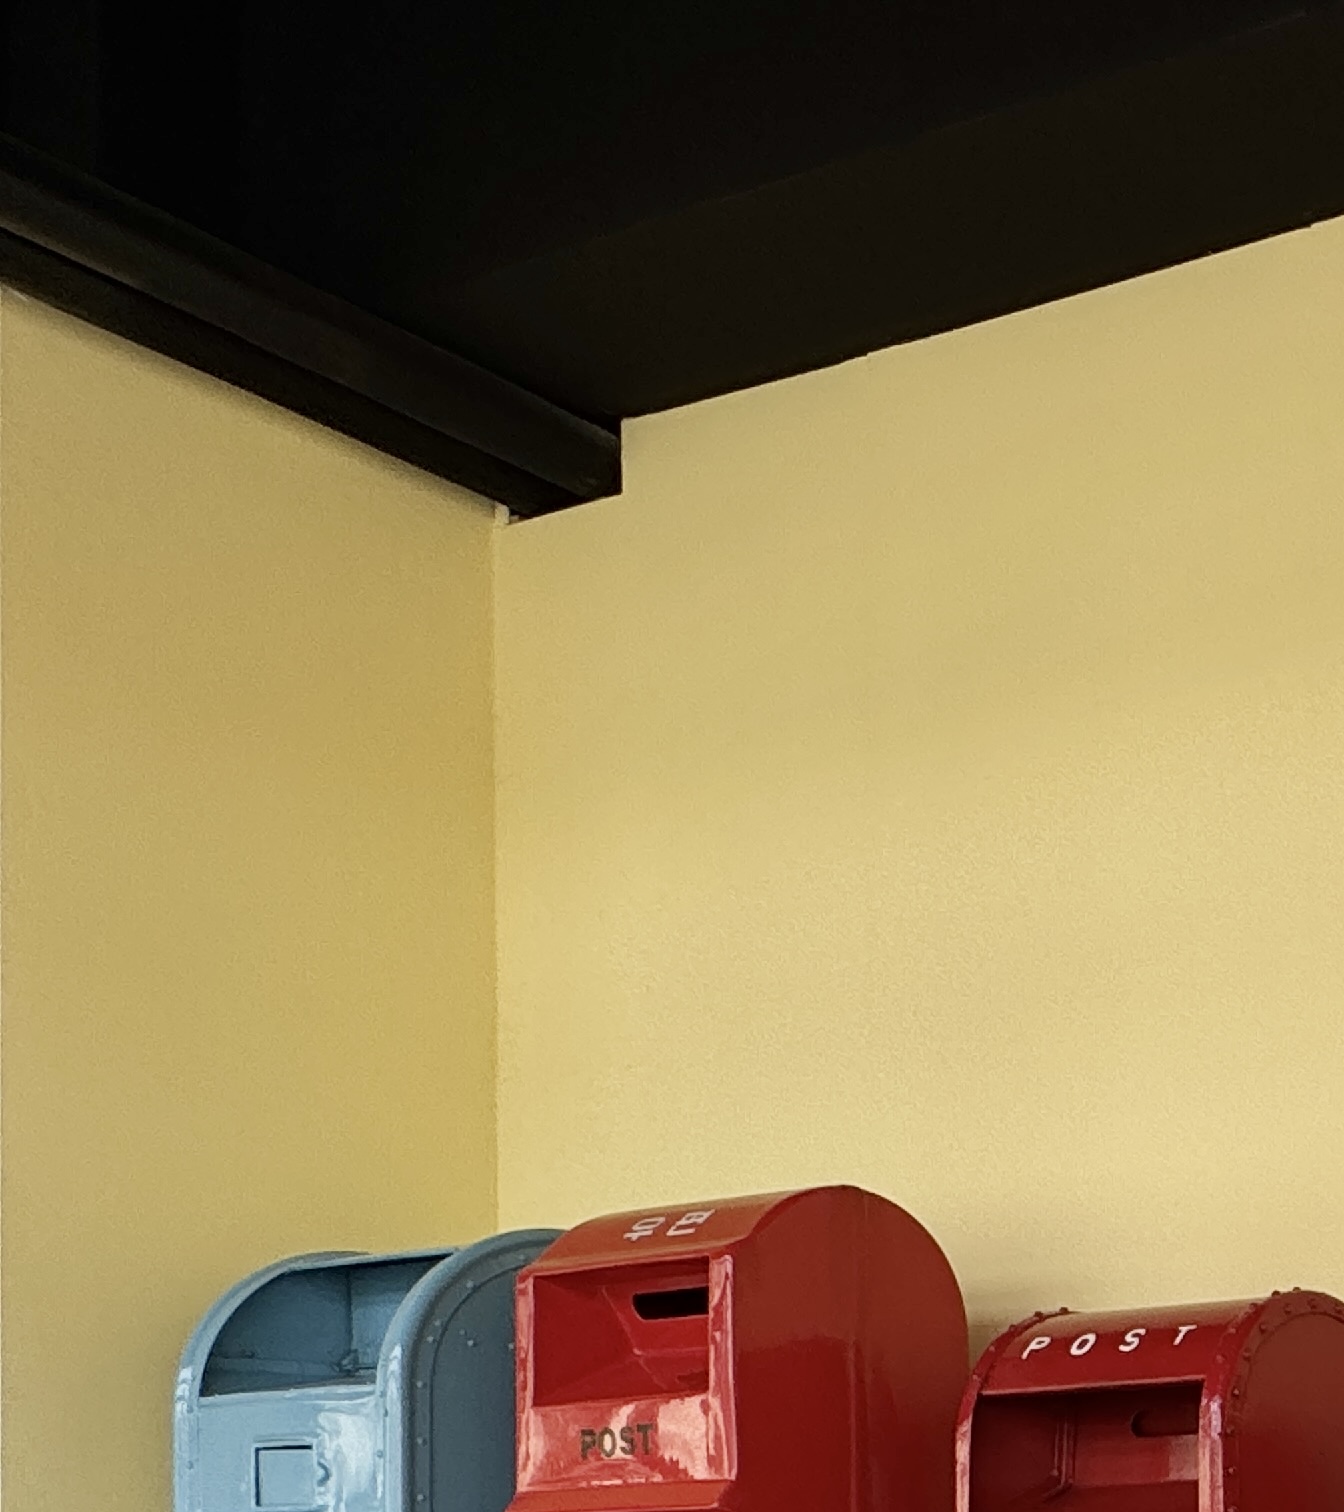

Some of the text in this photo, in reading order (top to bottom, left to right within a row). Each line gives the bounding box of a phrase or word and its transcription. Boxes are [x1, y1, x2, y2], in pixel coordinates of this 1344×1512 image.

[623, 1209, 715, 1241] 우편
[1021, 1325, 1197, 1360] POST
[581, 1423, 653, 1460] POST
